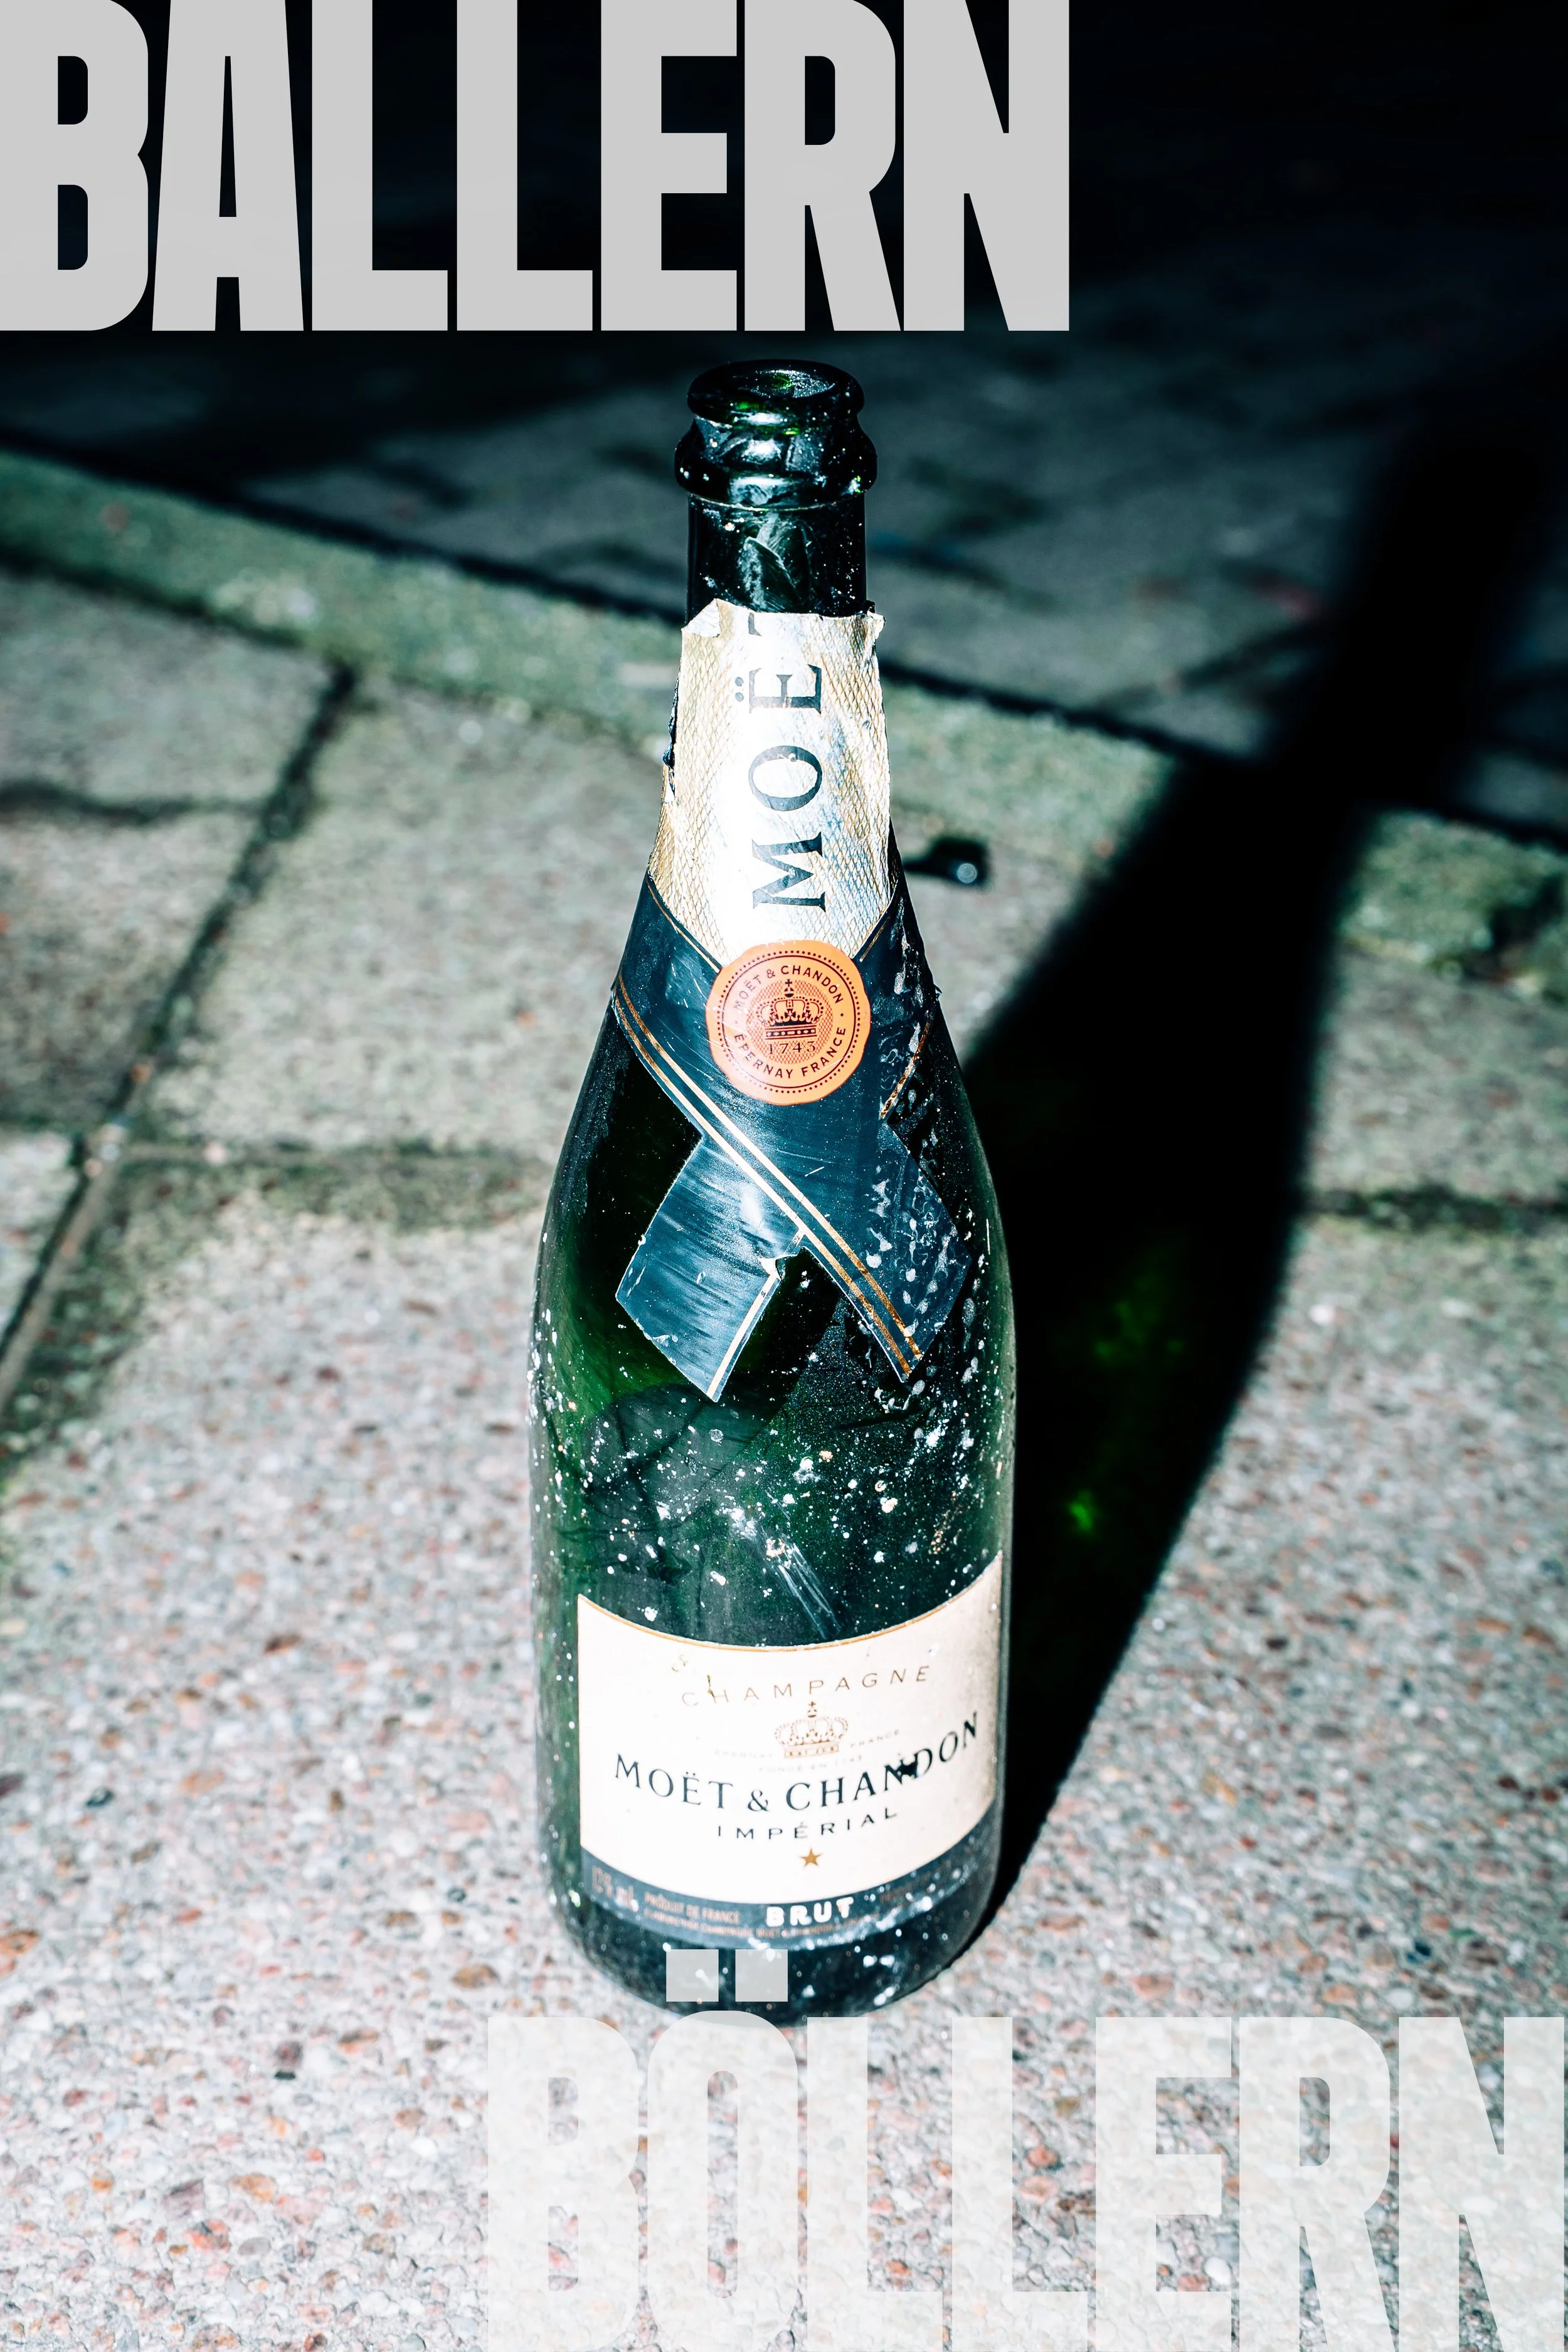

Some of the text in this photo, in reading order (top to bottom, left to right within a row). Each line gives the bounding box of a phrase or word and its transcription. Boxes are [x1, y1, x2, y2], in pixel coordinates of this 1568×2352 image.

[733, 965, 844, 1011] MOËT & CHANDON
[767, 1041, 817, 1055] 1743
[802, 1027, 846, 1077] FRANCE
[682, 1665, 931, 1707] CHAMPAGNE
[615, 1711, 979, 1813] MOËT & CHANDON
[718, 1808, 898, 1840] IMPÉRIAL
[766, 1897, 854, 1927] BRUT
